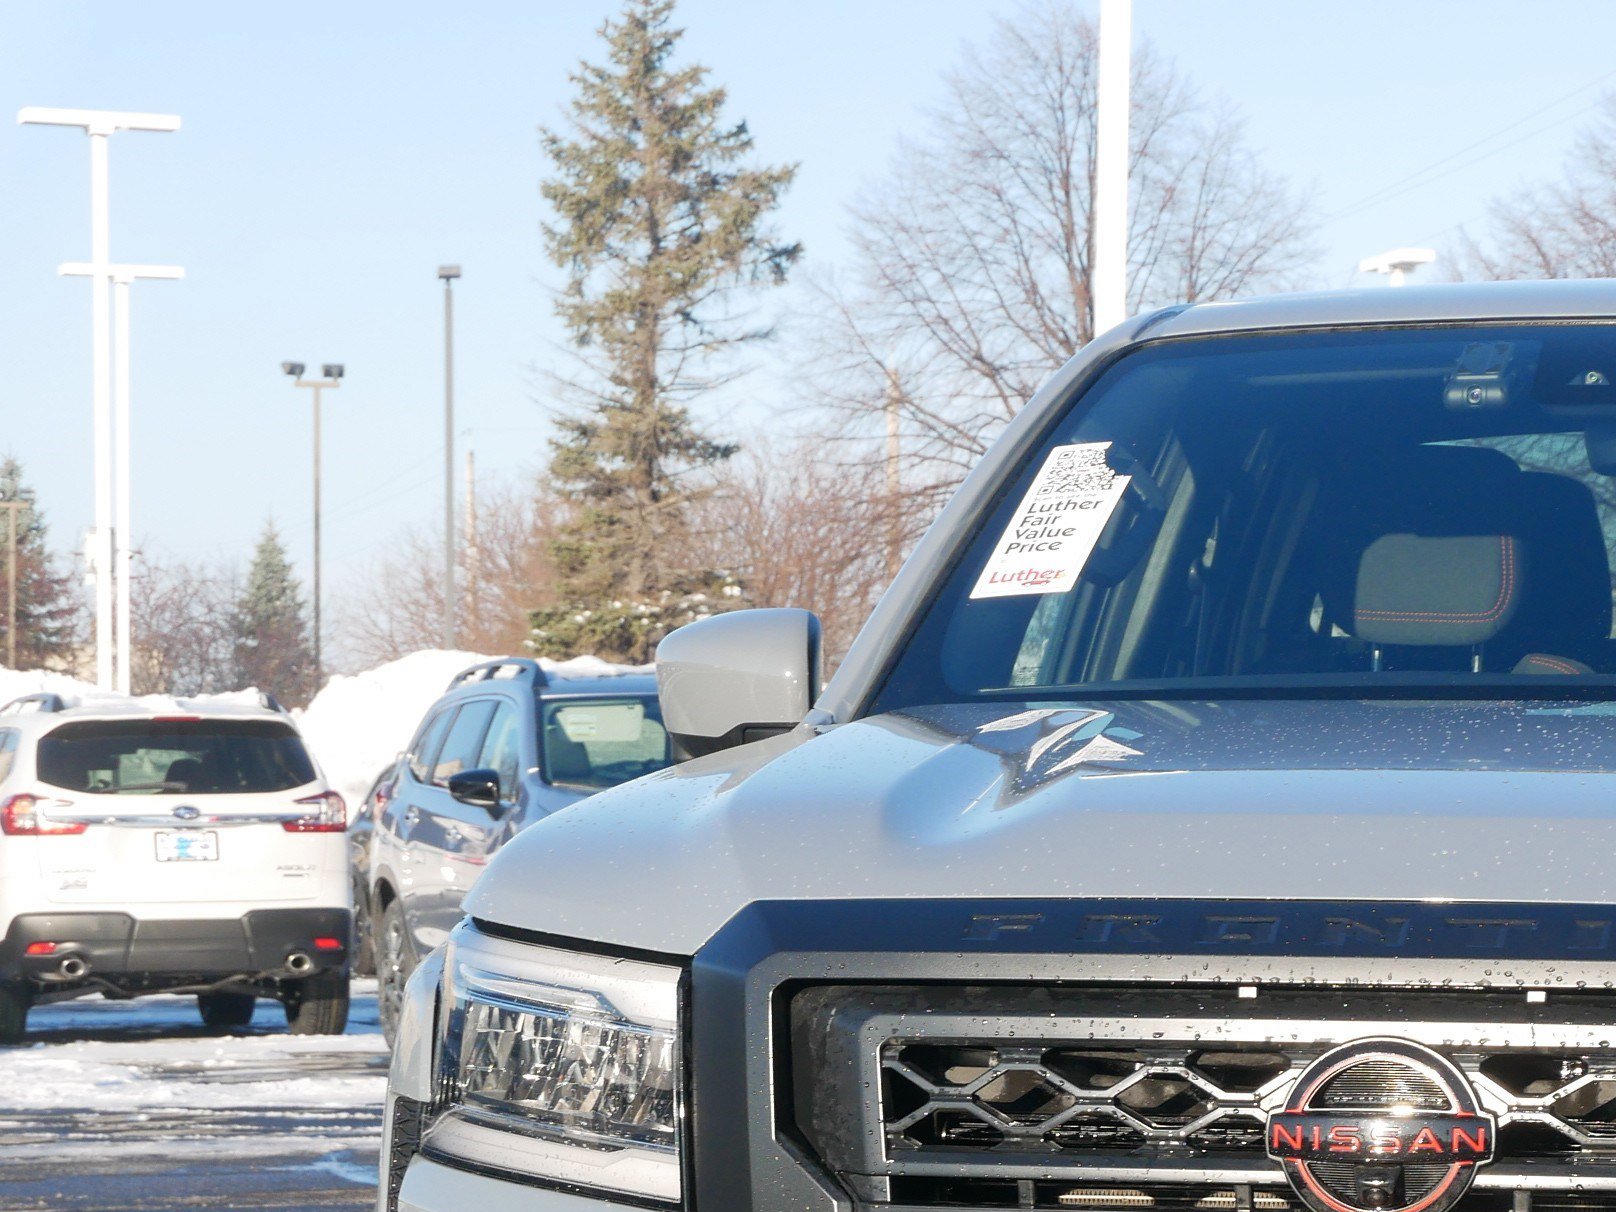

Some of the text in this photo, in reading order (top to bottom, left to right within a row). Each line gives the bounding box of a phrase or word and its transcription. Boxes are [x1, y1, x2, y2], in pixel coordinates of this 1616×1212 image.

[1028, 500, 1103, 514] Luther
[1020, 513, 1061, 527] Fair
[1015, 527, 1076, 540] Value
[1005, 540, 1062, 554] Price
[989, 568, 1065, 584] Luther
[1271, 1123, 1486, 1154] NISSAN
